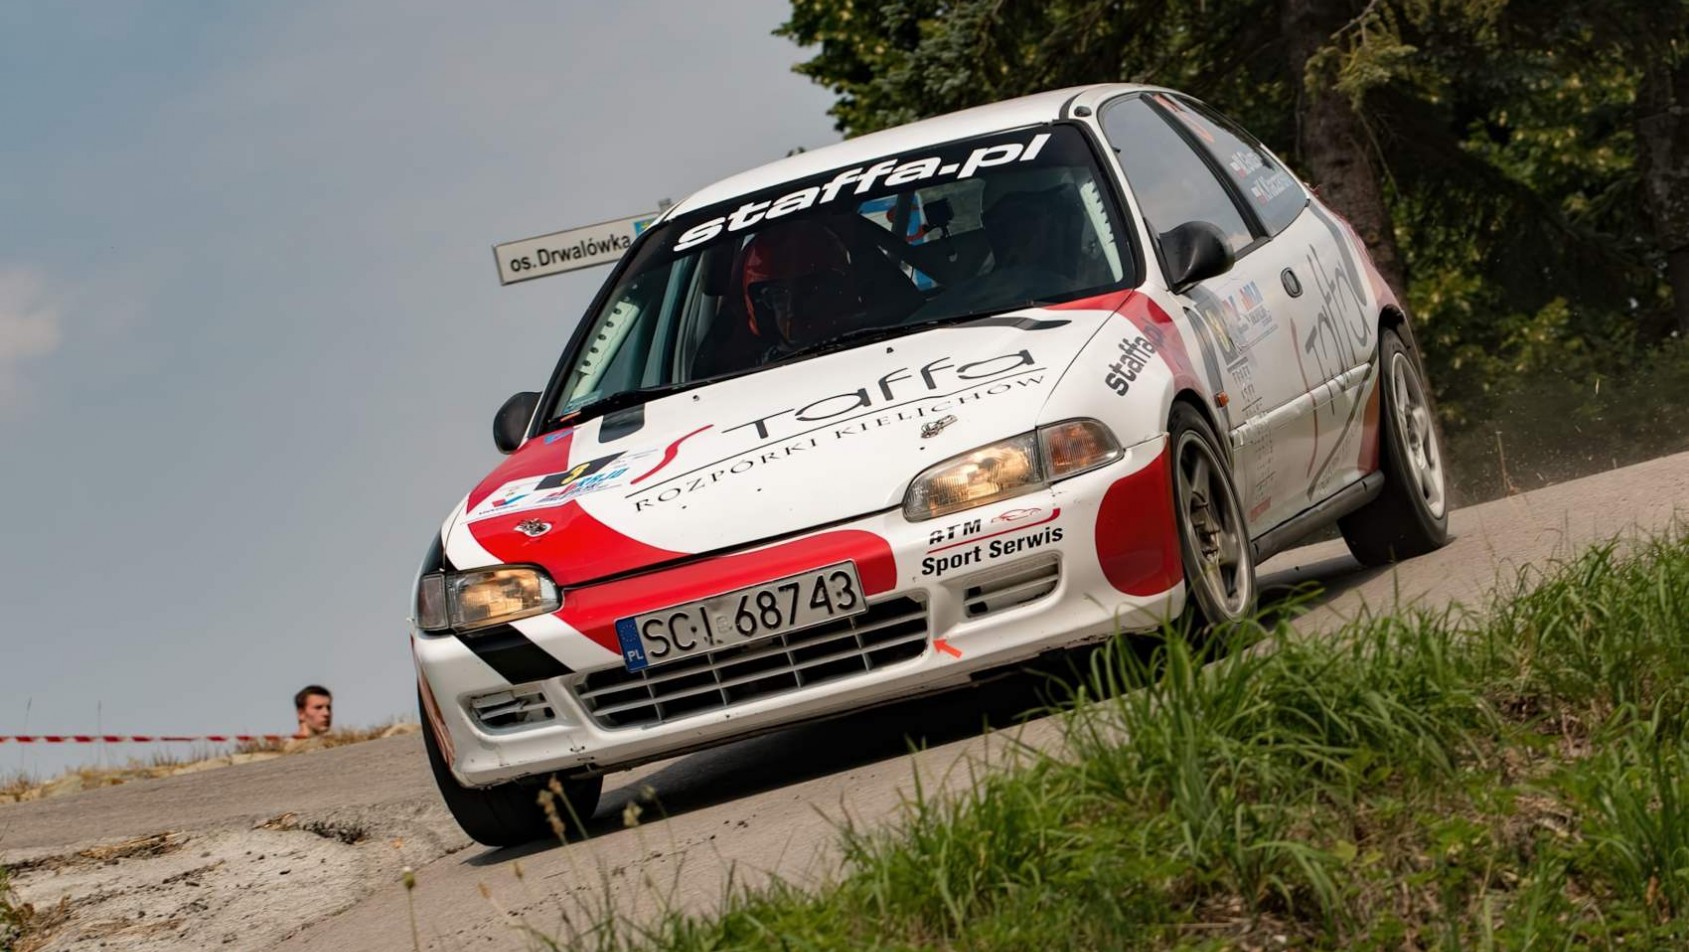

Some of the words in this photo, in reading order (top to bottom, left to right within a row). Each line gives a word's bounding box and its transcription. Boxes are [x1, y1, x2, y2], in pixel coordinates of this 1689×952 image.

[673, 133, 1052, 252] staffa.pl
[635, 437, 817, 512] ROZPÓRKI
[835, 374, 1045, 439] KIELICHÓW
[921, 545, 983, 577] Sport
[989, 526, 1064, 559] Serwis
[929, 518, 982, 546] ATM
[642, 606, 715, 658] SCI
[735, 570, 858, 637] 68743
[627, 650, 644, 663] PL
